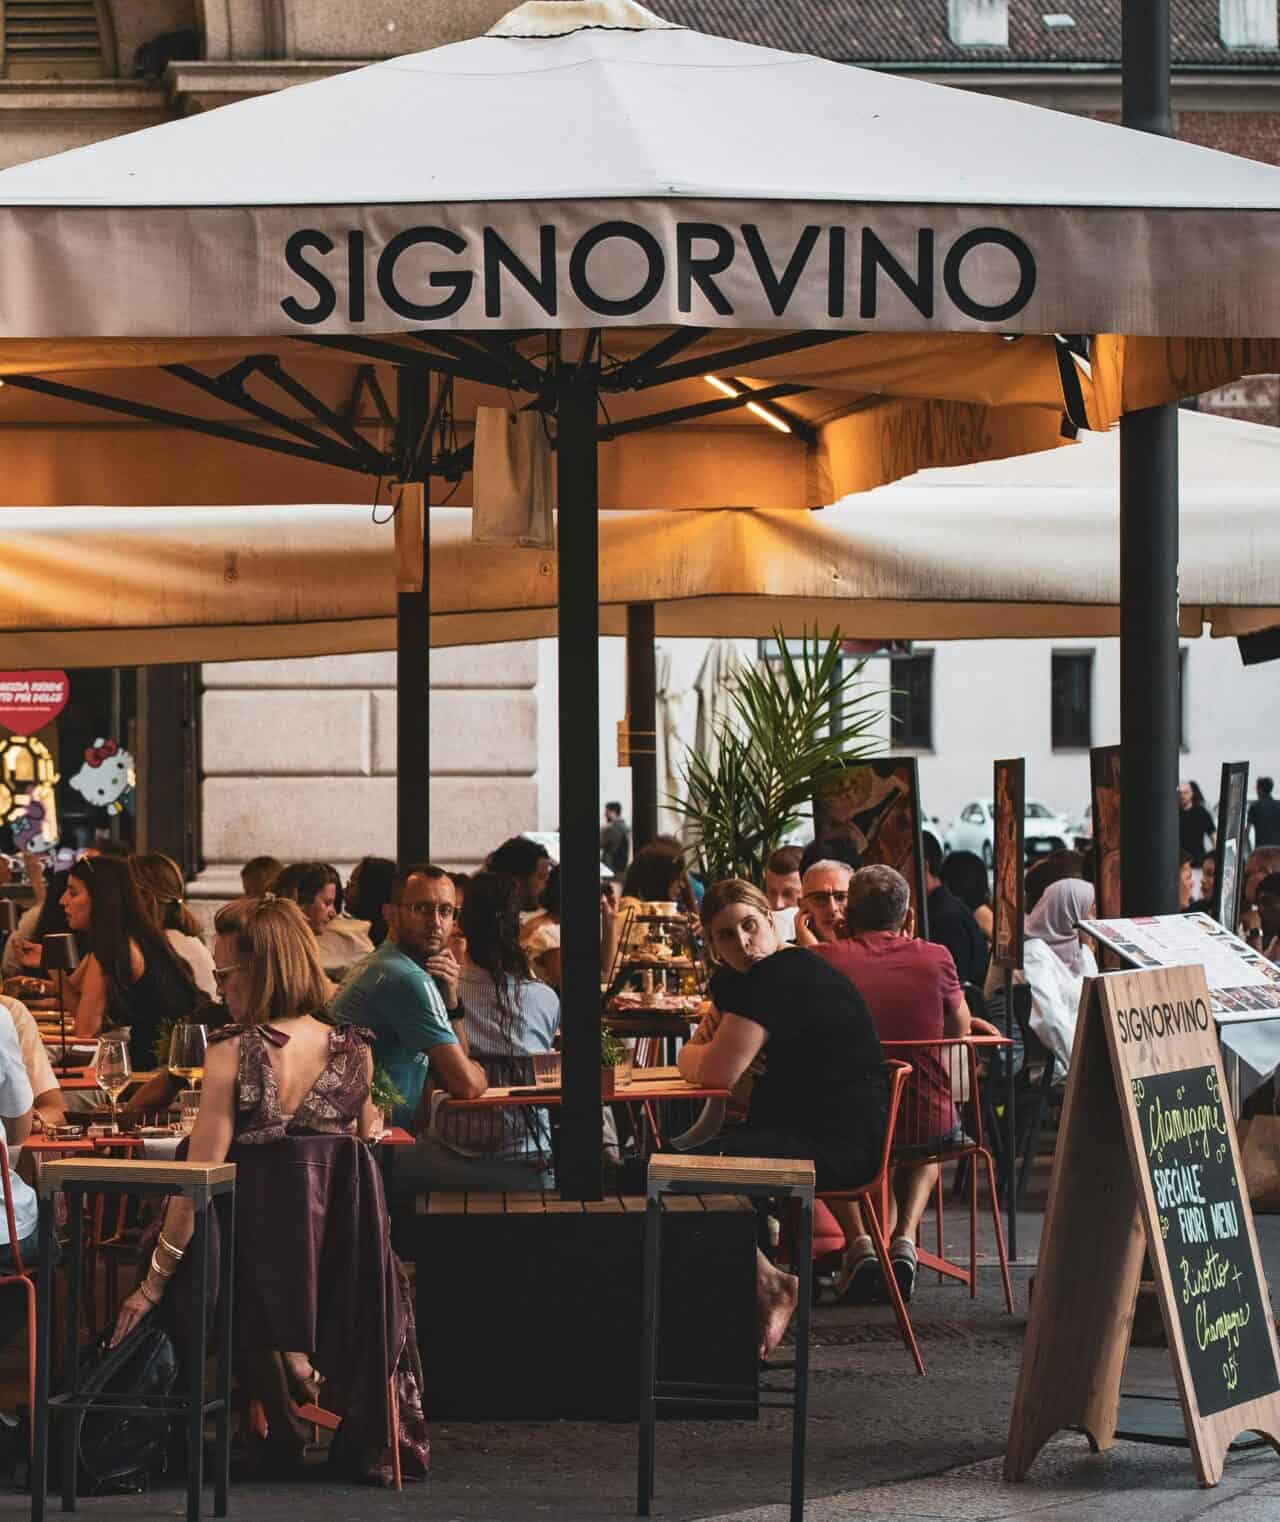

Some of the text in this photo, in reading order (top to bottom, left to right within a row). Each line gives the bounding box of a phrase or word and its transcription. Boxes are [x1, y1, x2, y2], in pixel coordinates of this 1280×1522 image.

[280, 220, 1038, 325] SIGNORVINO
[1117, 998, 1208, 1043] SIGNORVINO
[1148, 1096, 1228, 1159] Champagne
[1177, 1200, 1239, 1244] FUORI MENU
[1179, 1245, 1230, 1305] Risotto
[1195, 1300, 1251, 1351] Champagne
